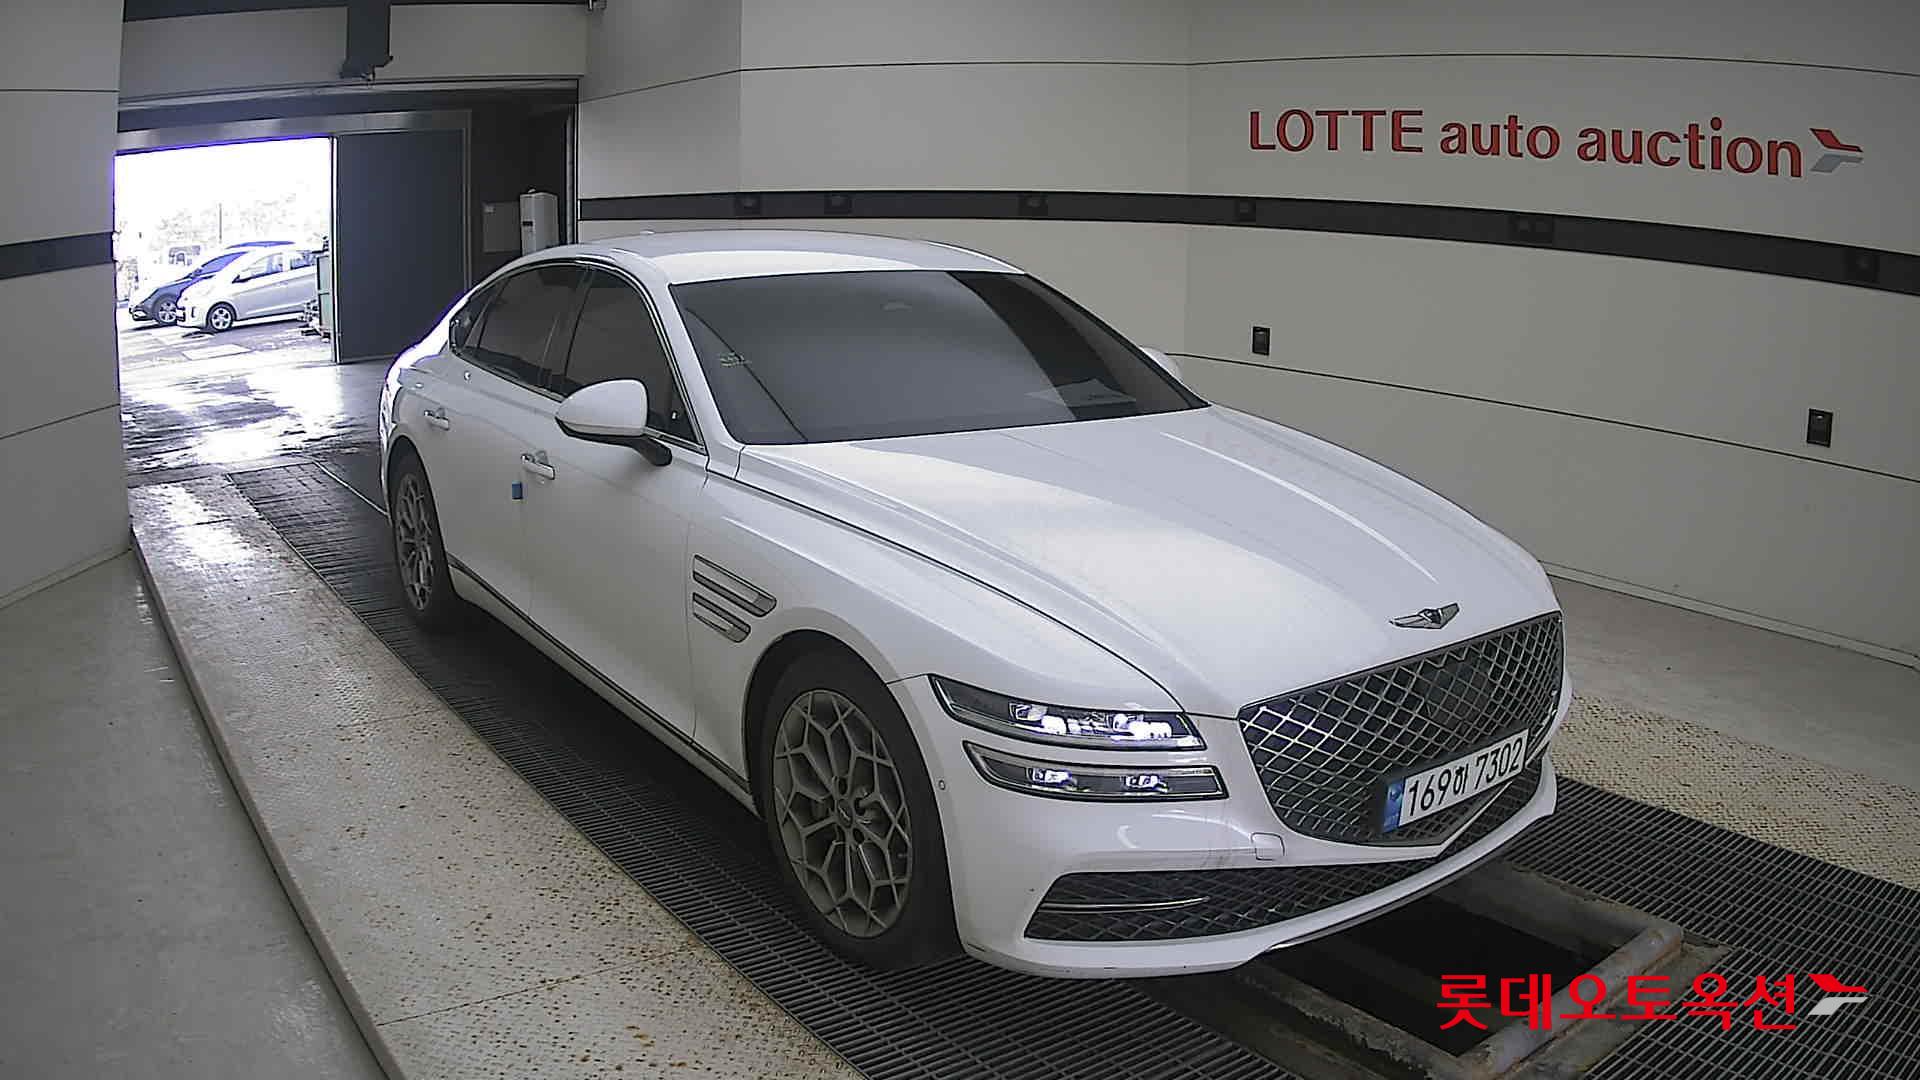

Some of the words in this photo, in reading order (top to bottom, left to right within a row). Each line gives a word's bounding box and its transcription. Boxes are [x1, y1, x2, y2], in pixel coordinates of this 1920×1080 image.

[1250, 109, 1424, 153] LOTTE
[1440, 115, 1560, 159] auto
[1576, 116, 1803, 178] auction
[1474, 737, 1523, 789] 7302
